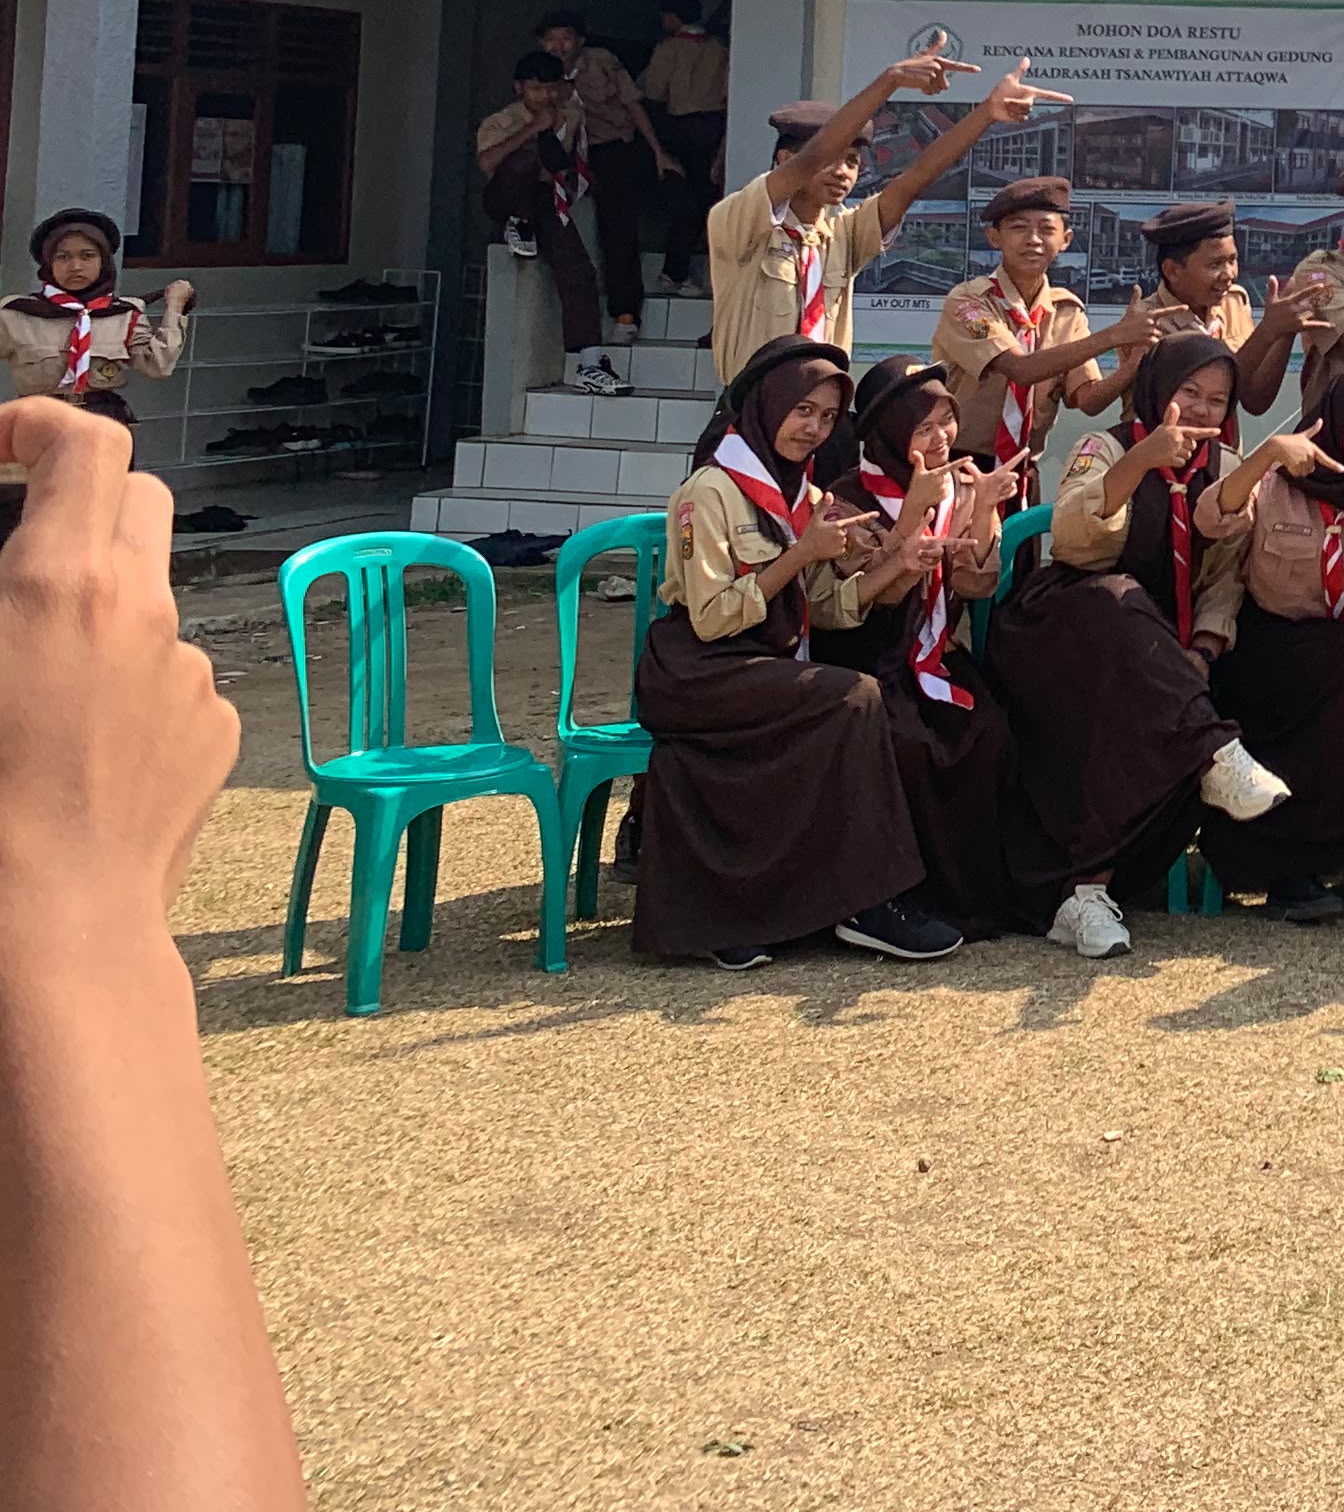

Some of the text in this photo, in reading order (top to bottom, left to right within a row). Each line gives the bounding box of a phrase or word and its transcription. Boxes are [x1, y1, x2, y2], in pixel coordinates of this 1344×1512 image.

[1076, 23, 1241, 39] MOHON DOA RESTU
[983, 44, 1333, 63] RENCANA RENOVASI & PEMBANGUNAN GEDUNG
[1025, 66, 1288, 85] MADRASAH TSANAWIYAH ATTAQWA
[871, 299, 888, 308] LAY
[890, 299, 911, 309] OUT
